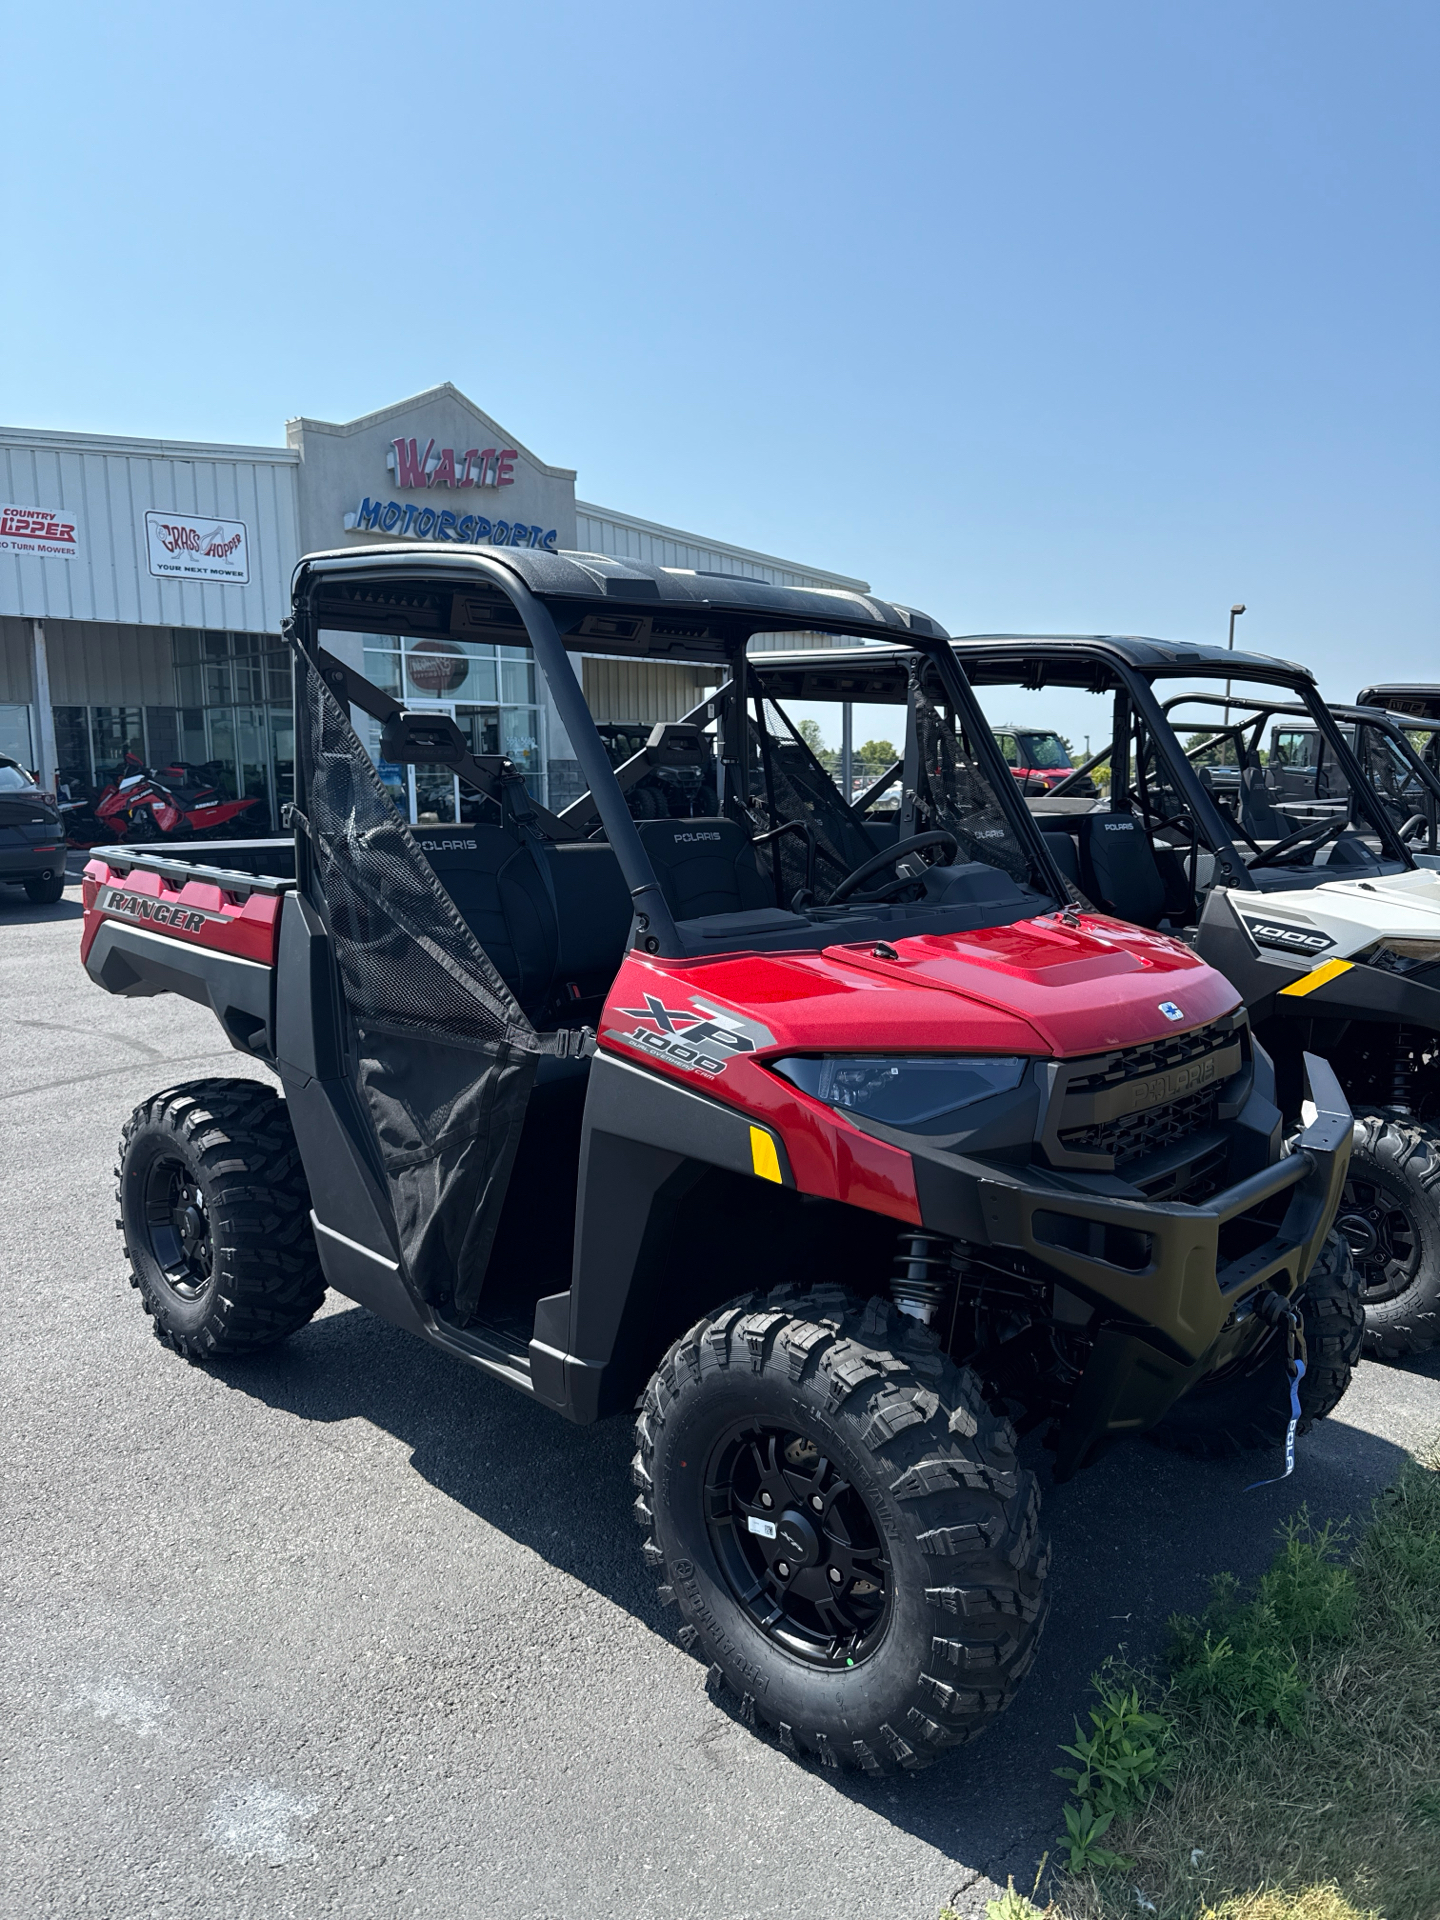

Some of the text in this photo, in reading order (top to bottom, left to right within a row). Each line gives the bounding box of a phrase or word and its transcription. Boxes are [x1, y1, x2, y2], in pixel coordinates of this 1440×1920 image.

[392, 437, 518, 489] WAITE
[3, 508, 56, 520] COUNTRY
[356, 497, 558, 550] MOTORSPORTS
[10, 541, 35, 551] TURN
[37, 544, 76, 555] MOWERS
[157, 563, 182, 572] YOUR
[210, 569, 244, 577] MOWER
[674, 832, 721, 843] POLARIS
[974, 829, 1005, 840] OLARIS
[1105, 823, 1134, 831] POLARIS
[107, 890, 206, 934] RANGER
[1251, 924, 1331, 948] 1000
[612, 991, 757, 1054] XP
[628, 1039, 716, 1080] DUAL OVERHEAD CAM
[632, 1026, 728, 1075] 1000
[1131, 1058, 1215, 1108] POLARIS
[1286, 1419, 1298, 1474] POLA
